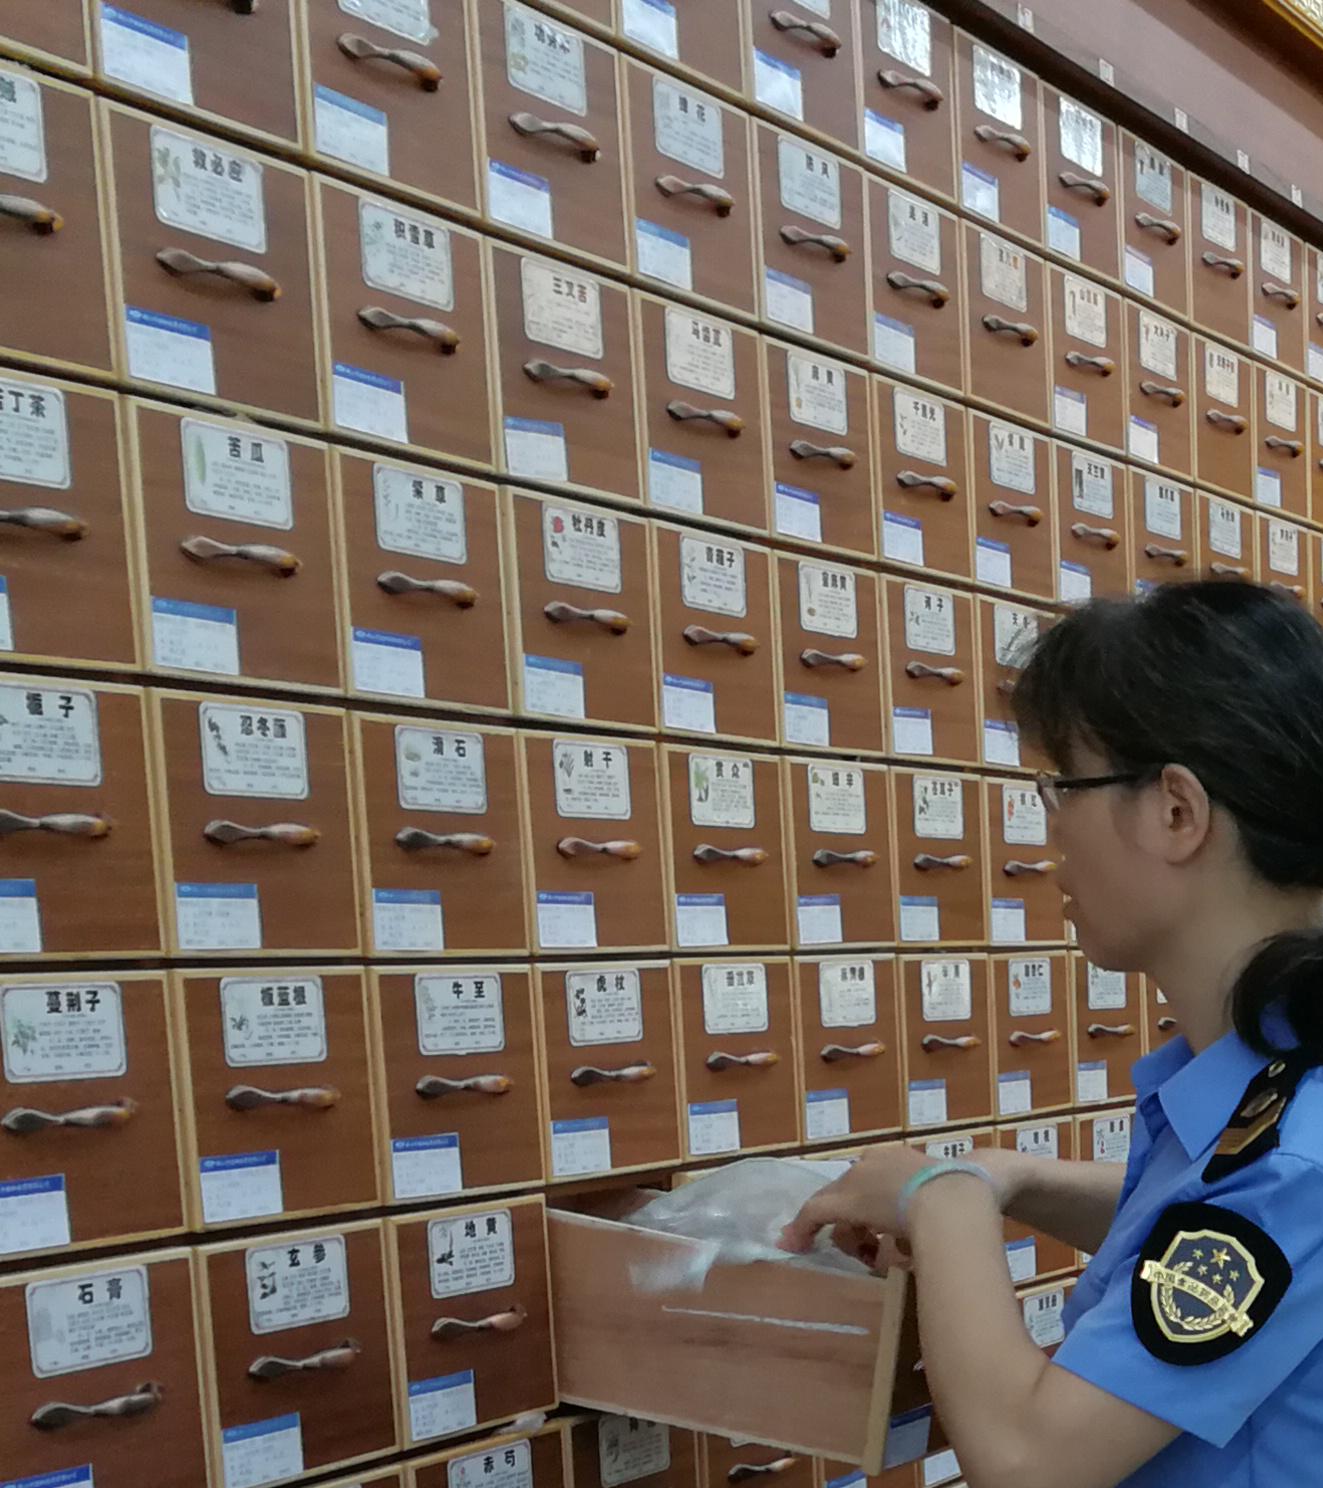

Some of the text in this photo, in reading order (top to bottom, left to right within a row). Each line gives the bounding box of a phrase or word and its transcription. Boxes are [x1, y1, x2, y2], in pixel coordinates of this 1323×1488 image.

[228, 436, 265, 464] 苦瓜
[411, 480, 448, 504] 紫草
[25, 691, 75, 719] 栀子
[240, 714, 288, 740] 忍冬藤
[432, 735, 467, 758] 滑石
[583, 750, 613, 768] 射干
[452, 981, 486, 1000] 牛至
[596, 974, 626, 993] 虎杖
[45, 989, 101, 1015] 蔓荆子
[260, 986, 307, 1007] 板蓝根
[464, 1217, 498, 1239] 地黄
[78, 1276, 123, 1305] 石膏
[483, 1449, 516, 1475] 赤芍
